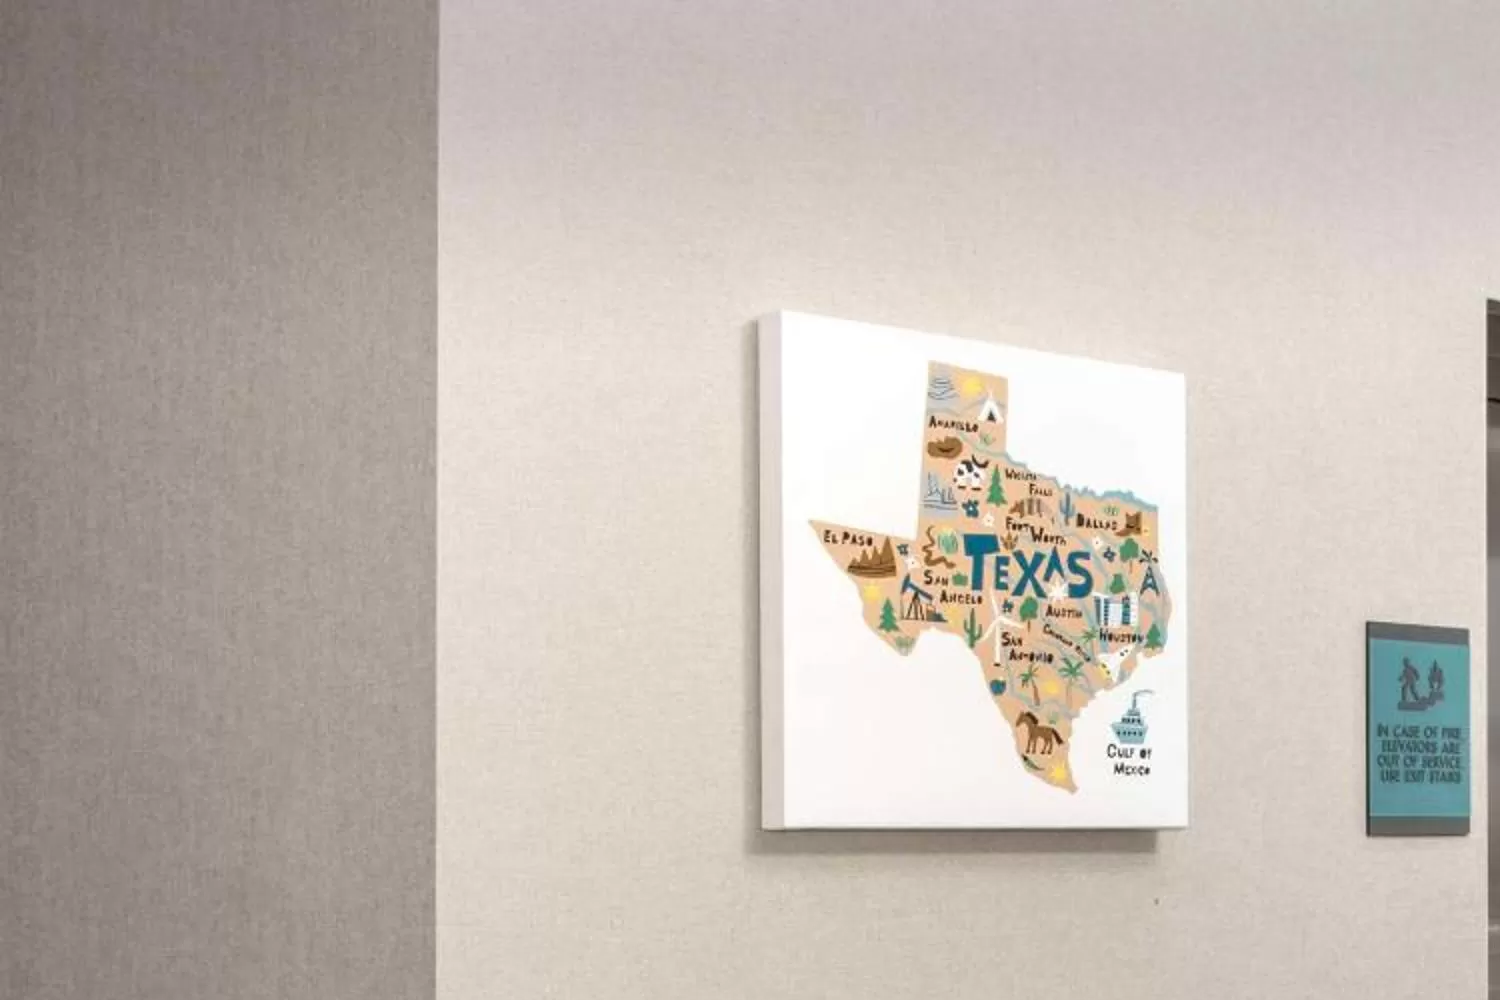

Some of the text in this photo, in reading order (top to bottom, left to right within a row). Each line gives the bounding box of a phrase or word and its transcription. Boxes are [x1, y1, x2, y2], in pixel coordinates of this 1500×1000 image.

[1076, 513, 1117, 530] DALLAS
[823, 530, 873, 546] EL PASO
[1030, 526, 1066, 545] WORTH
[963, 534, 1093, 598] TEXAS
[924, 569, 948, 586] SAN
[940, 590, 983, 605] ANGELO
[1046, 604, 1082, 618] AUSTIN
[1001, 632, 1023, 647] SAN
[1100, 628, 1144, 643] HOUSTON
[1377, 724, 1389, 738] IN
[1393, 725, 1420, 738] CASE
[1424, 725, 1438, 738] OF
[1107, 743, 1134, 758] GULF
[1377, 754, 1399, 768] OUT
[1403, 755, 1417, 768] OF
[1114, 762, 1150, 776] MEXICO
